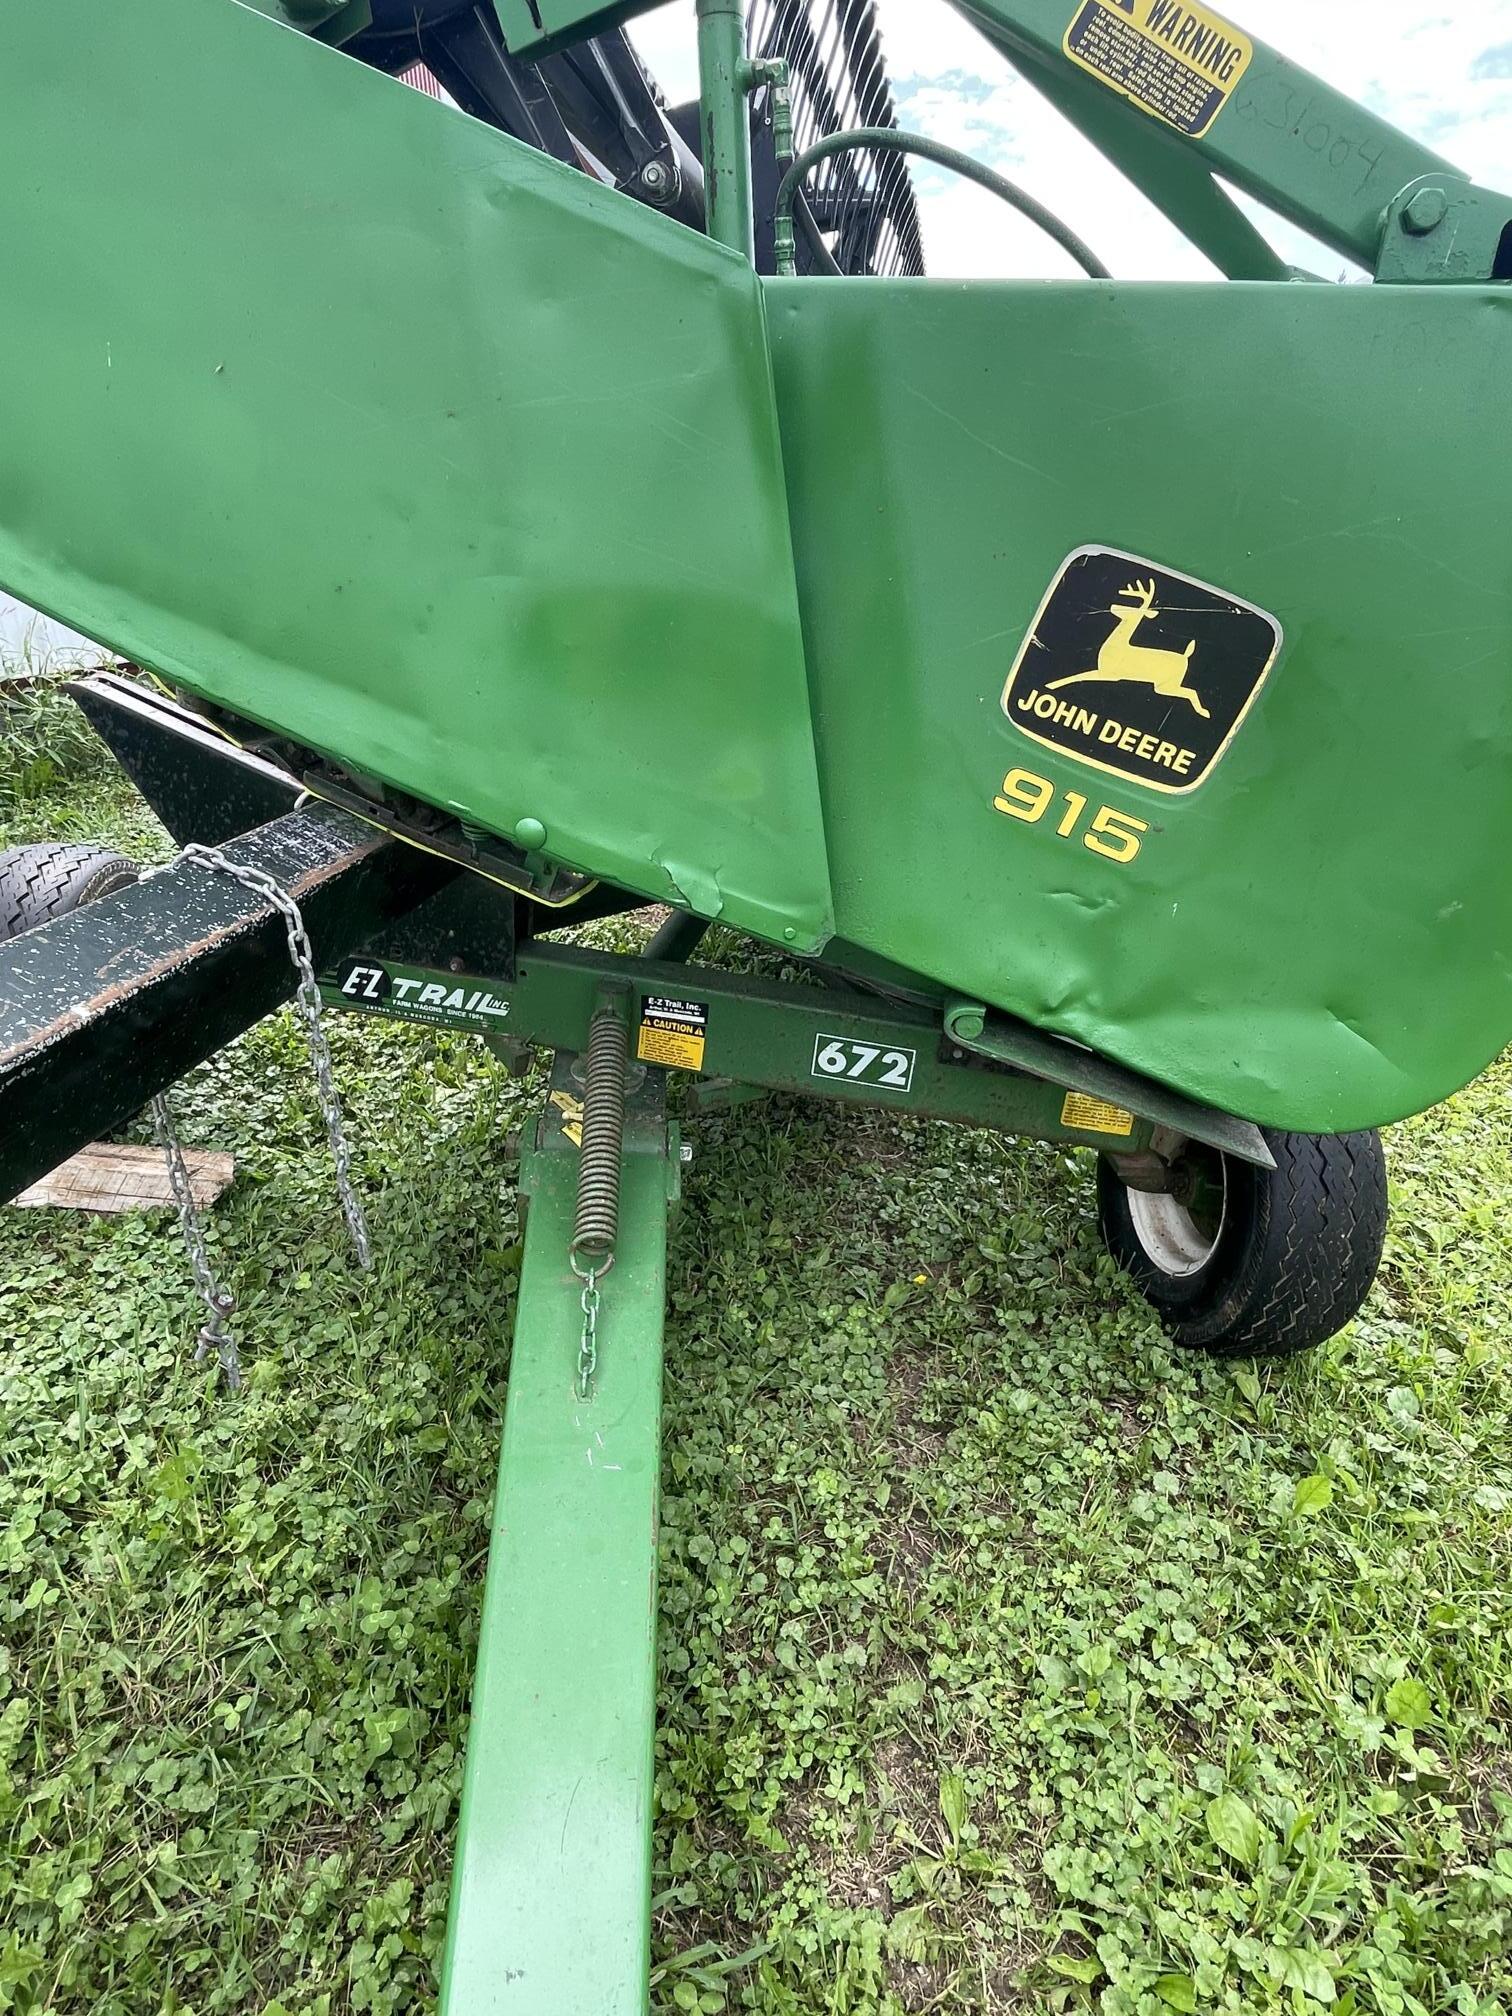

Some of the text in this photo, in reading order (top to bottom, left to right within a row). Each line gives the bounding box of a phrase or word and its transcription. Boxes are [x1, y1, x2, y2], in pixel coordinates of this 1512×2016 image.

[1083, 30, 1199, 115] each lift cylinder rod before working on
[1087, 23, 1110, 42] remove
[1110, 38, 1126, 53] start
[1140, 60, 1154, 72] and
[1152, 68, 1164, 79] set
[1162, 75, 1182, 93] safety
[1180, 88, 1195, 102] stop
[1194, 98, 1204, 108] on
[1097, 6, 1214, 93] To avoid bodily injury from fall of raised
[1107, 26, 1142, 54] completely
[1141, 49, 1158, 64] raise
[1172, 71, 1186, 85] stop
[1144, 0, 1242, 83] WARNING
[1075, 46, 1084, 55] on
[1083, 52, 1099, 66] each
[1098, 61, 1112, 74] reel
[1110, 70, 1124, 82] arm
[1122, 78, 1142, 95] above
[1141, 91, 1166, 112] cylinder
[1079, 38, 1087, 46] or
[1089, 45, 1108, 61] under
[1127, 70, 1148, 89] Safety
[1148, 86, 1163, 100] stop
[1163, 96, 1171, 105] is
[1171, 102, 1196, 123] located
[1018, 689, 1196, 774] JOHN DEERE
[993, 768, 1150, 863] 915
[341, 966, 383, 998] E-Z
[392, 977, 510, 1017] TRAIL
[392, 999, 411, 1009] FARM
[412, 1002, 443, 1014] WAGONS
[447, 1008, 467, 1018] SINCE
[648, 997, 663, 1006] E-Z
[664, 1000, 684, 1009] Trail,
[685, 1002, 702, 1012] Inc.
[653, 1018, 693, 1034] CAUTION
[818, 1041, 908, 1085] 672
